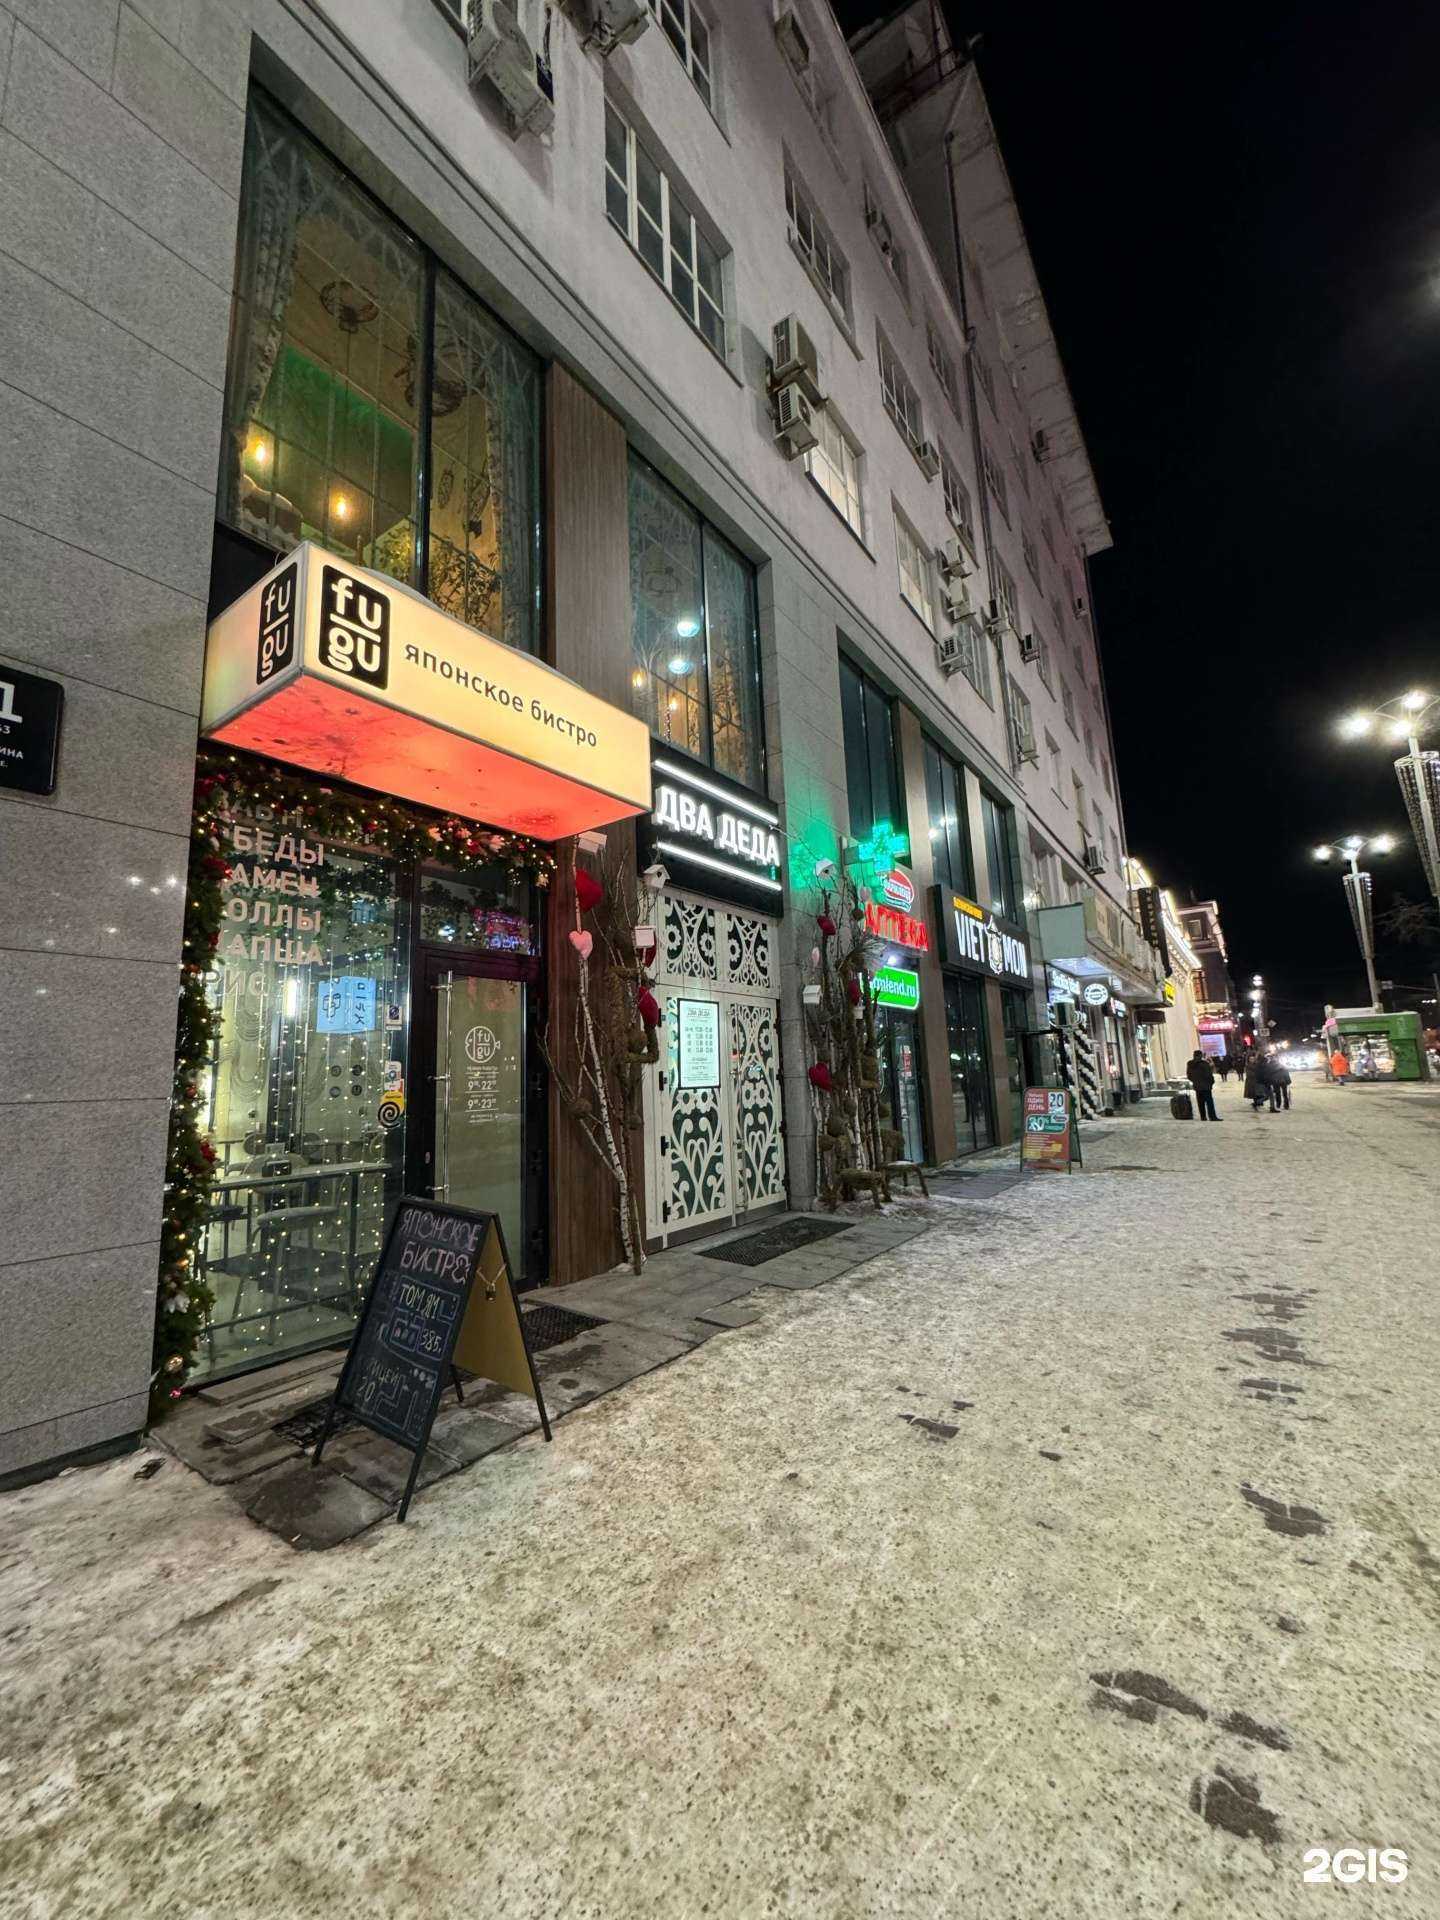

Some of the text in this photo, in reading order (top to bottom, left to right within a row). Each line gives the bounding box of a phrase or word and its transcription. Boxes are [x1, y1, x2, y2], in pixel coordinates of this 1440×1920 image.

[264, 579, 291, 623] fu
[331, 577, 382, 630] fu
[261, 623, 289, 678] gu
[327, 627, 381, 673] gu
[405, 643, 597, 747] японское бистро
[222, 826, 325, 866] БЕДЫ
[653, 785, 780, 867] ДВА ДЕДА
[222, 862, 321, 898] АМЕН
[226, 897, 321, 933] ОЛЛЫ
[954, 910, 1028, 979] VIET MON
[476, 1029, 491, 1043] fu
[476, 1046, 491, 1060] gu
[401, 1208, 483, 1252] ЯПОНСКОЕ
[400, 1241, 472, 1285] БИСТРО
